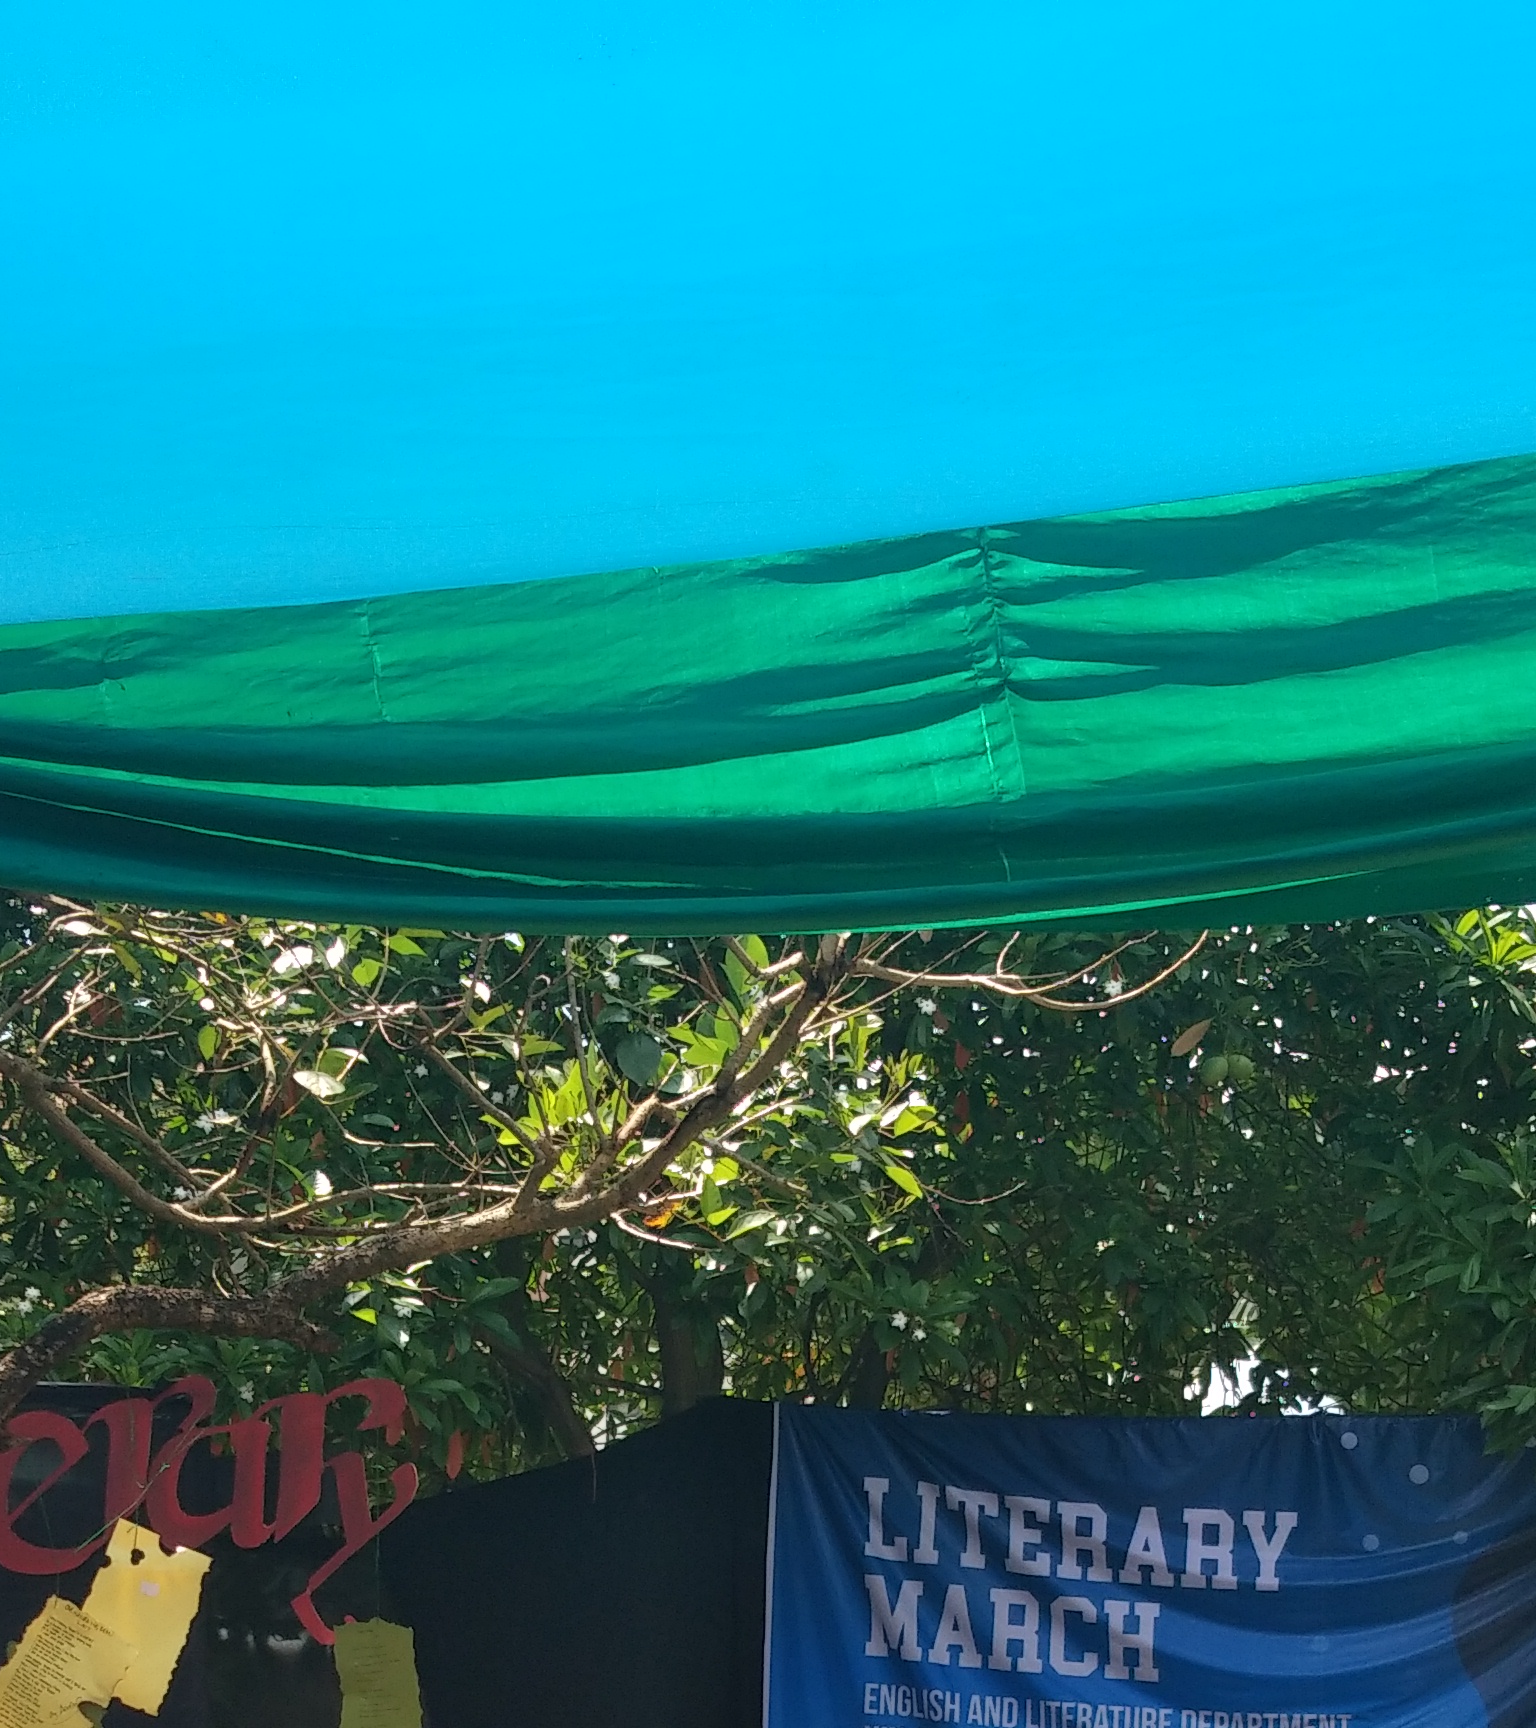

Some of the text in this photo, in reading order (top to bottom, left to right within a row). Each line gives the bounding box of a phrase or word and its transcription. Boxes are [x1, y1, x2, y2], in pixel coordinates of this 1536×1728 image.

[864, 1476, 1298, 1592] LITERARY
[865, 1574, 1161, 1683] MARCH
[864, 1682, 961, 1724] ENGLISH
[966, 1694, 1019, 1728] AND
